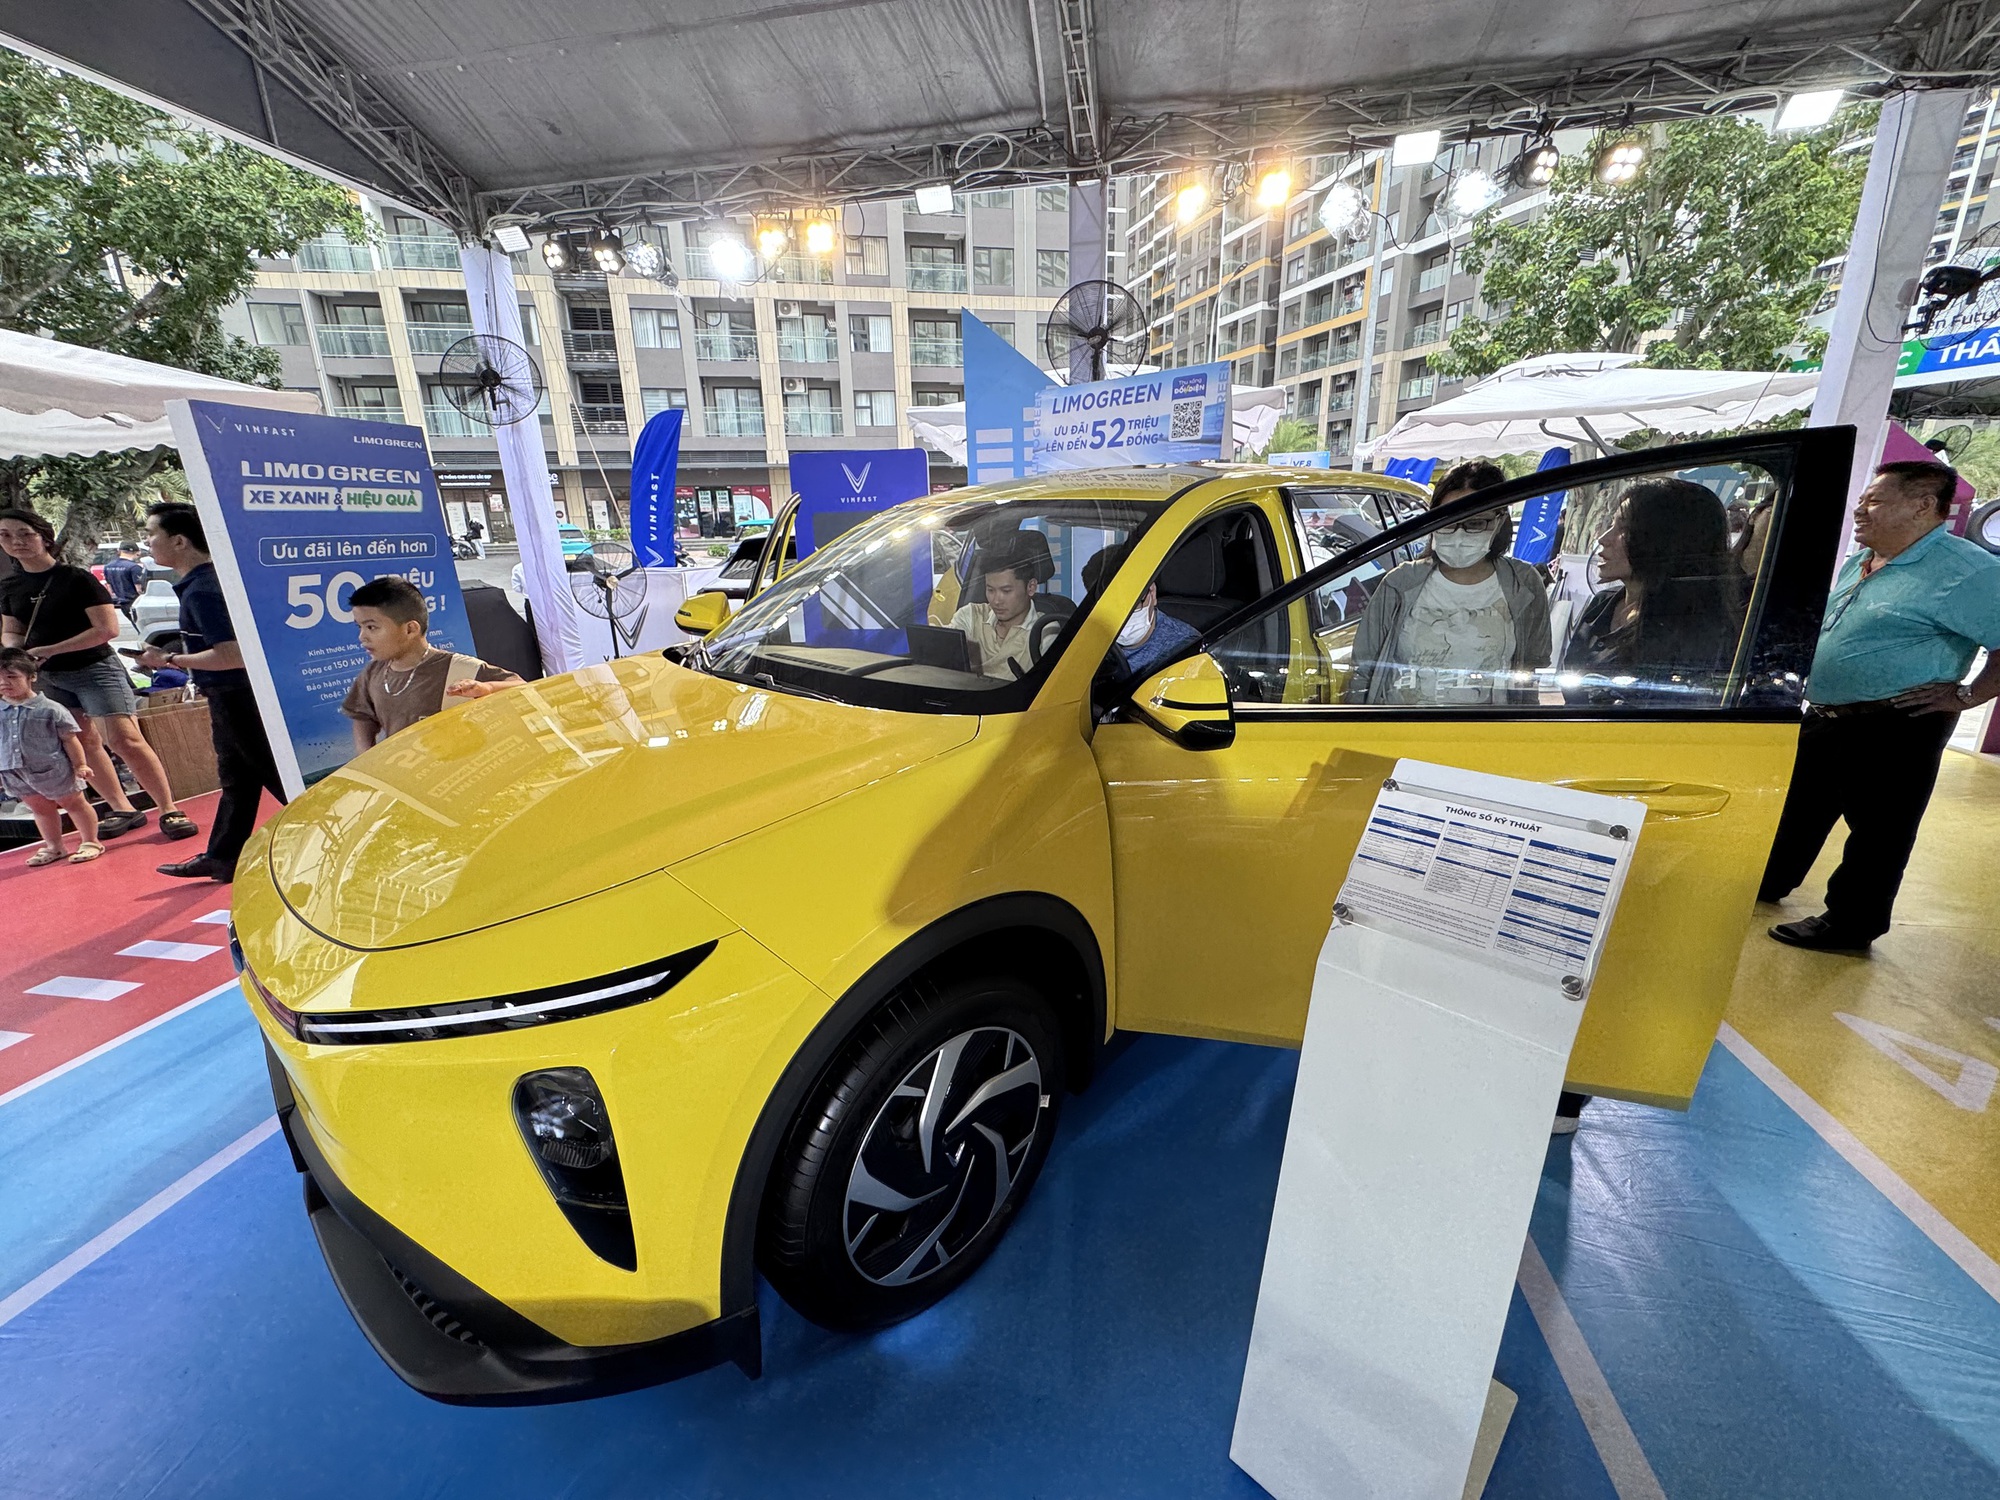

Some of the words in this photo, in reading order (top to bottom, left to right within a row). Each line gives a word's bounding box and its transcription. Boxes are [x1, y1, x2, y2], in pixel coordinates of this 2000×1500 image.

[1052, 382, 1162, 415] LIMOGREEN
[234, 423, 297, 437] VINFAST
[1054, 424, 1069, 436] ƯU
[1070, 421, 1089, 435] ĐÃI
[1089, 417, 1126, 450] 52
[1128, 415, 1159, 430] TRIỆU
[1045, 438, 1066, 453] LÊN
[1067, 437, 1088, 451] ĐẾN
[249, 490, 275, 504] XE
[279, 491, 329, 505] XANH
[333, 493, 344, 506] &
[346, 489, 383, 508] HIỆU
[385, 489, 418, 507] QUẢ
[650, 473, 660, 542] VINFAST
[272, 543, 298, 559] Ưu
[304, 542, 332, 558] đãi
[337, 541, 362, 556] lên
[367, 538, 396, 555] đến
[400, 539, 428, 553] hơn
[285, 571, 366, 629] 50
[308, 648, 325, 657] Kính
[439, 641, 454, 650] inch
[302, 667, 323, 677] Động
[333, 660, 349, 669] 150
[350, 657, 365, 666] kW
[306, 681, 322, 692] Bảo
[322, 679, 342, 689] hành
[1445, 805, 1477, 818] THÔNG
[1479, 812, 1493, 821] SỐ
[1494, 816, 1508, 825] KỸ
[1509, 820, 1542, 833] THUẬT
